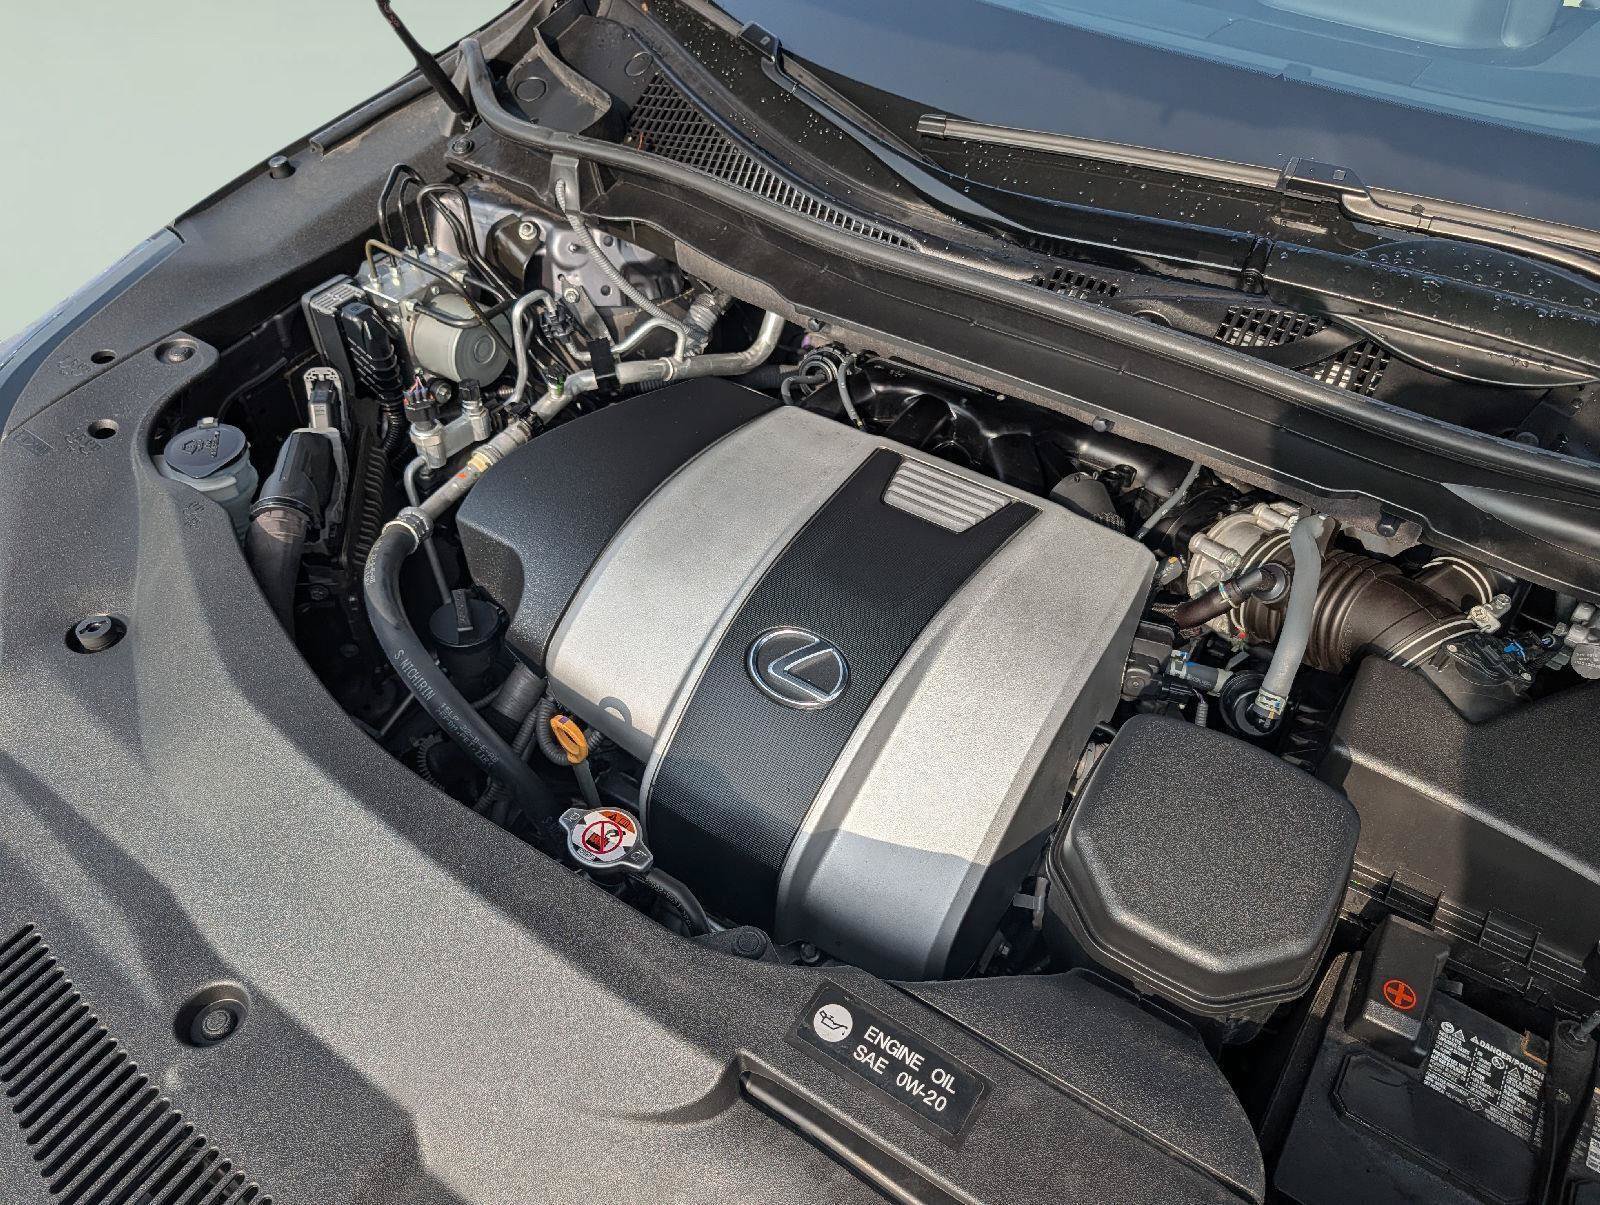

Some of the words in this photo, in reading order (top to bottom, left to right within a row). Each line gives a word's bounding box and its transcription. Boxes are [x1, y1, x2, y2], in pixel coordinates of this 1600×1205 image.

[853, 1044, 889, 1075] SAE
[896, 1071, 948, 1112] 0W-20
[863, 1025, 925, 1072] ENGINE
[931, 1068, 956, 1094] OIL
